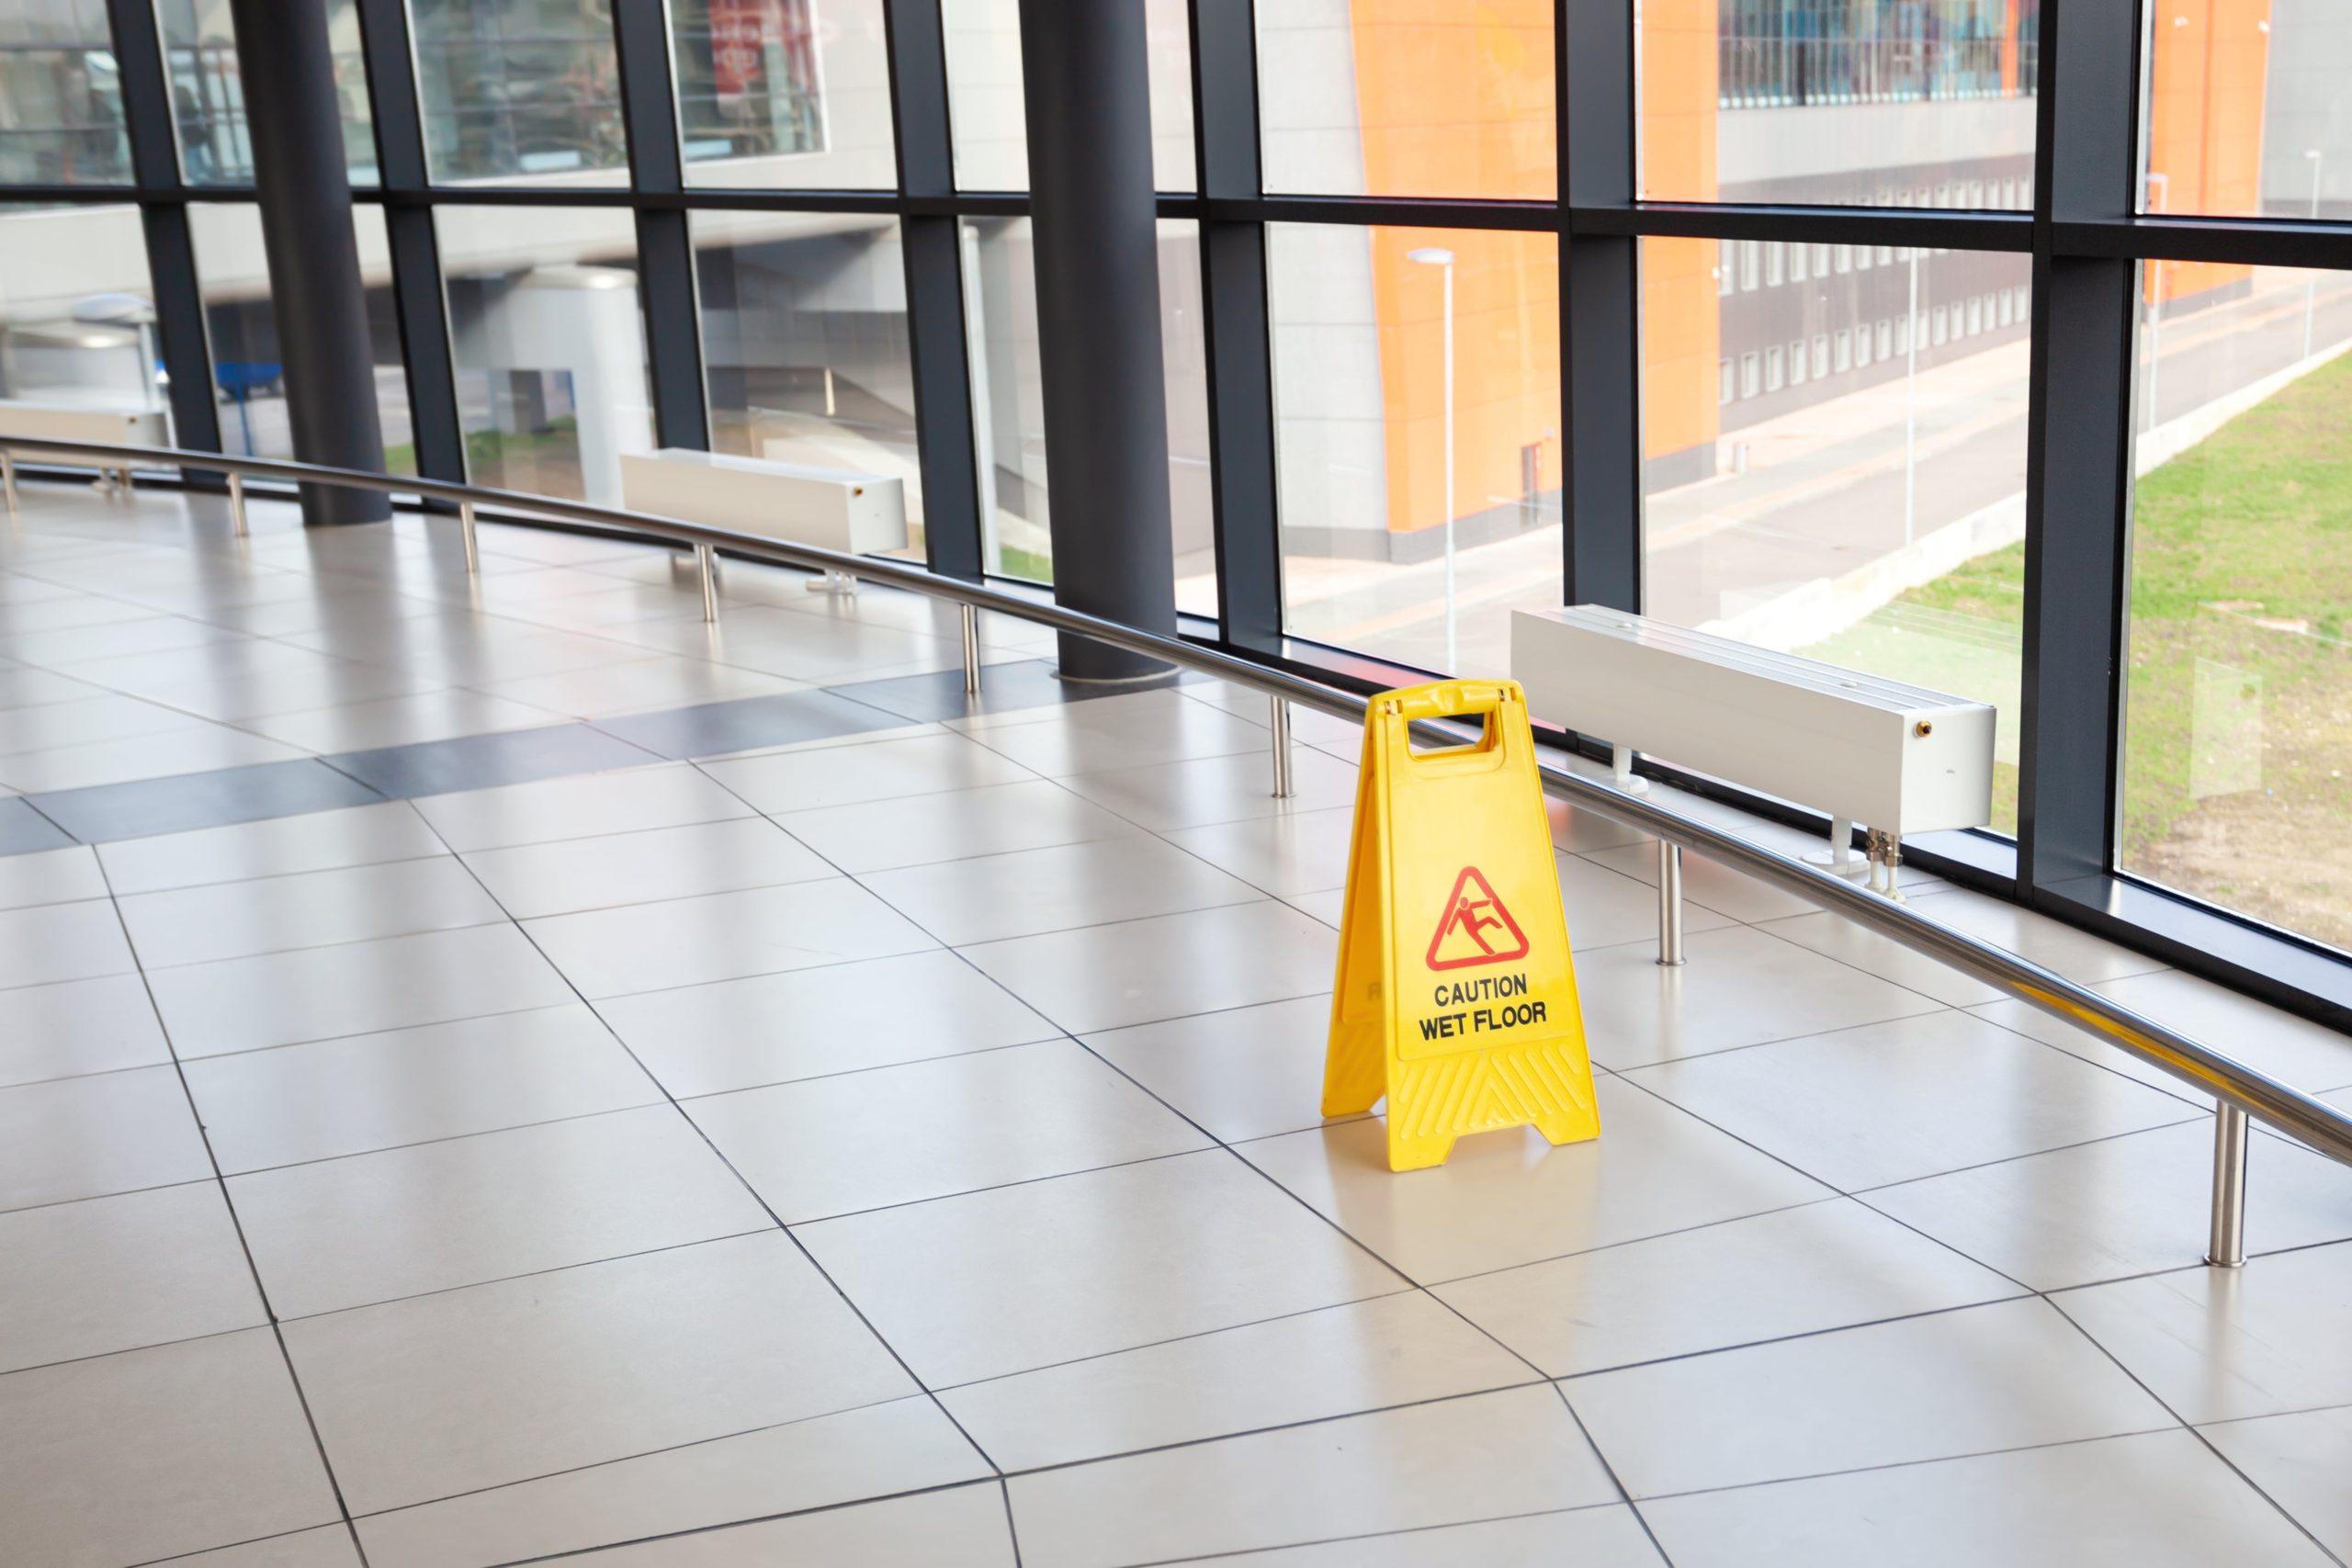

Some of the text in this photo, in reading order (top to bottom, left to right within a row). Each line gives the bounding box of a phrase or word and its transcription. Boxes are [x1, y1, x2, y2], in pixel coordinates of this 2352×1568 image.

[1434, 973, 1528, 1008] CAUTION
[1419, 1000, 1547, 1041] WET FLOOR
